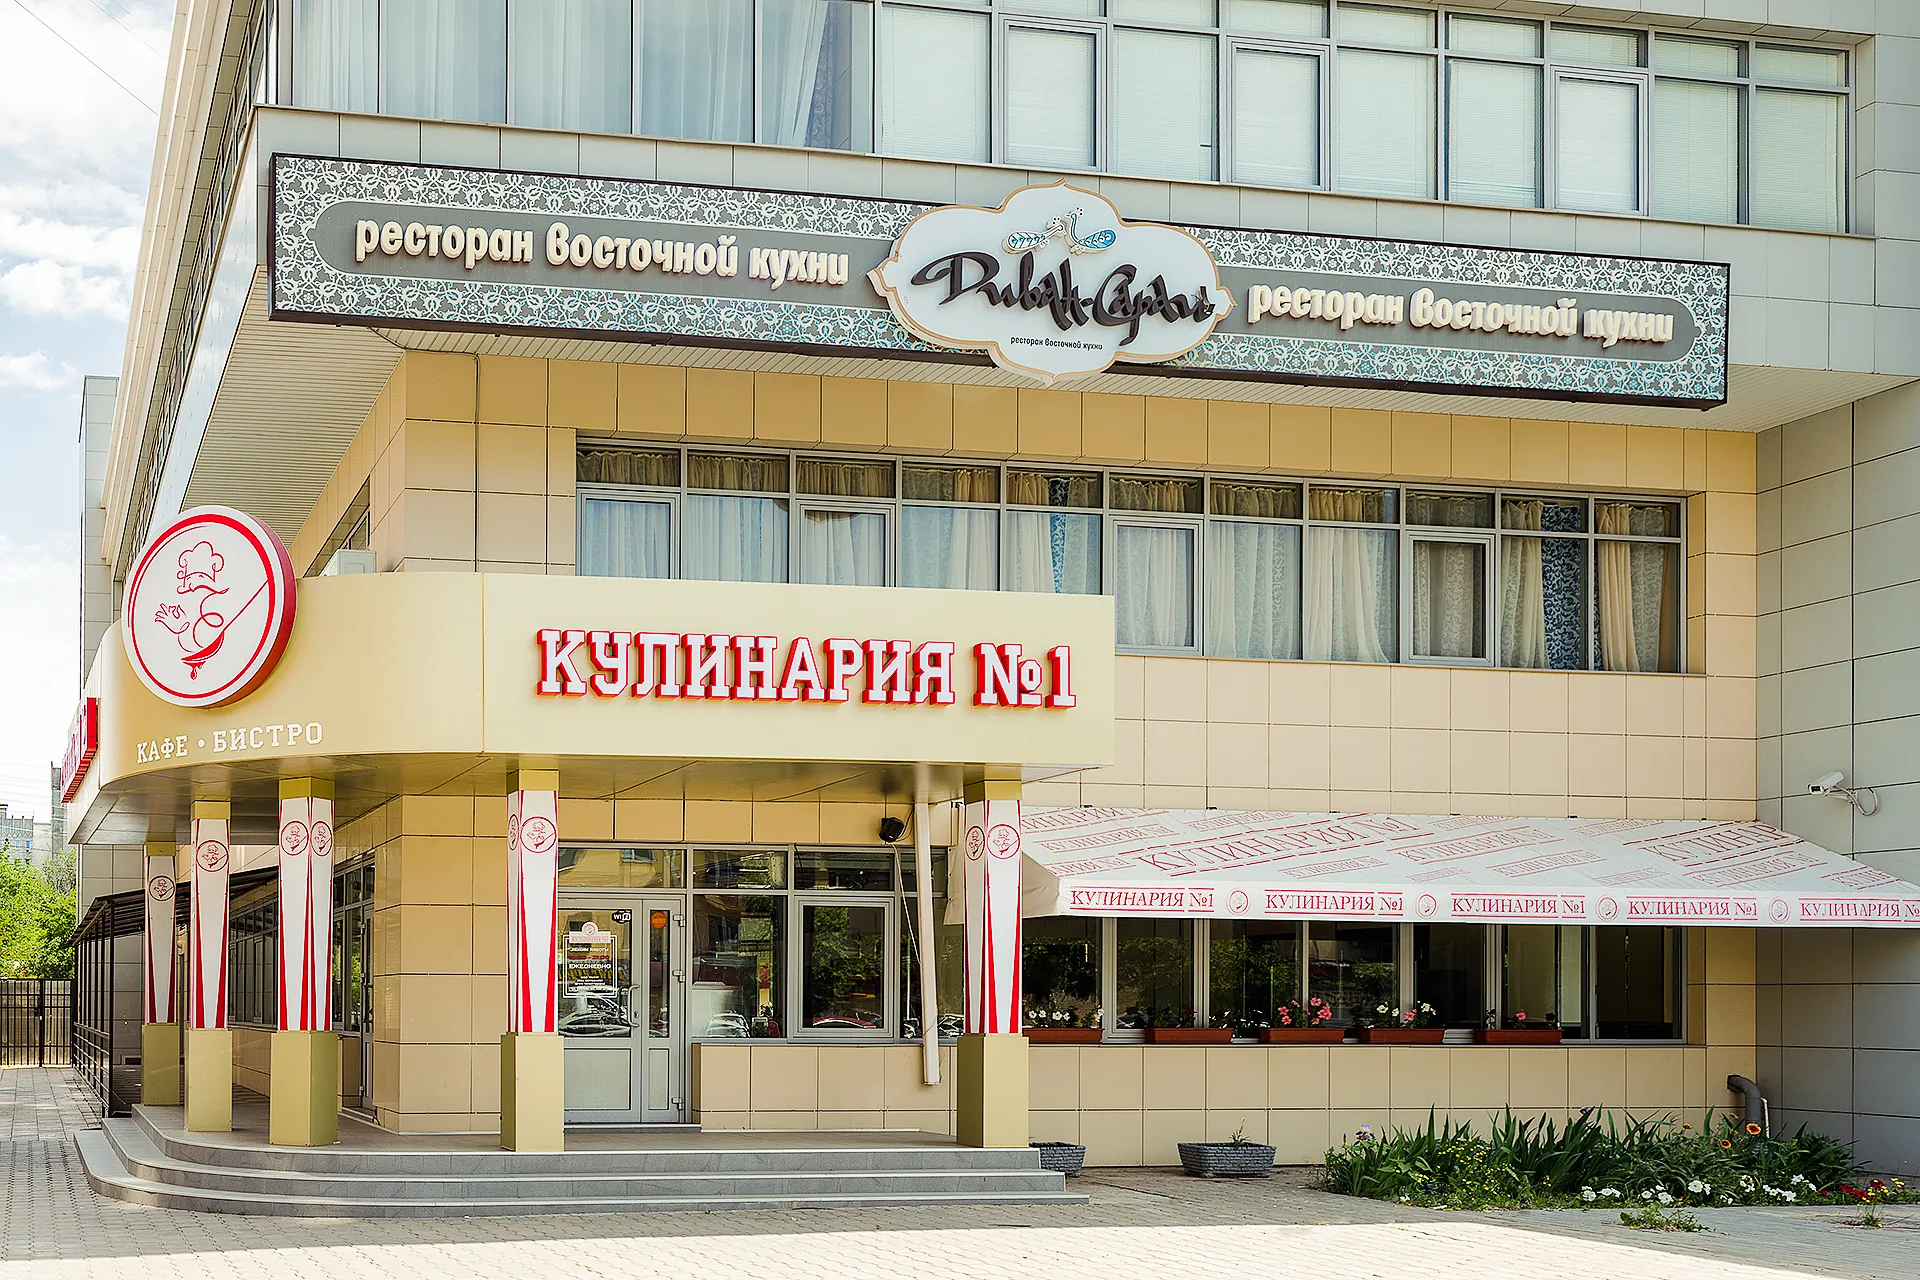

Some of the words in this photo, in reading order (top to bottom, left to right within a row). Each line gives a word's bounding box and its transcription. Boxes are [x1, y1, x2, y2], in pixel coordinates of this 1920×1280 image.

[355, 219, 534, 270] ресторан
[546, 221, 739, 277] восточной
[749, 246, 849, 290] кухни
[1247, 284, 1404, 330] ресторан
[1409, 287, 1578, 337] восточной
[1583, 309, 1674, 348] кухни
[1010, 336, 1043, 347] ресторан
[1044, 337, 1082, 349] восточной
[537, 629, 956, 706] КУЛИНАРИЯ
[973, 642, 1077, 708] №1
[136, 735, 189, 764] КАФЕ
[212, 721, 323, 753] БИСТРО
[1132, 825, 1369, 872] КУЛИНАРИЯ
[1070, 890, 1184, 908] КУЛИНАРИЯ
[1189, 891, 1214, 908] №1
[1265, 893, 1375, 911] КУЛИНАРИЯ
[1379, 895, 1404, 912] №1
[1452, 897, 1557, 914] КУЛИНАРИЯ
[1561, 899, 1585, 915] №1
[1627, 900, 1730, 916] КУЛИНАРИЯ
[1733, 901, 1758, 917] №1
[1800, 902, 1900, 918] КУЛИНАРИЯ
